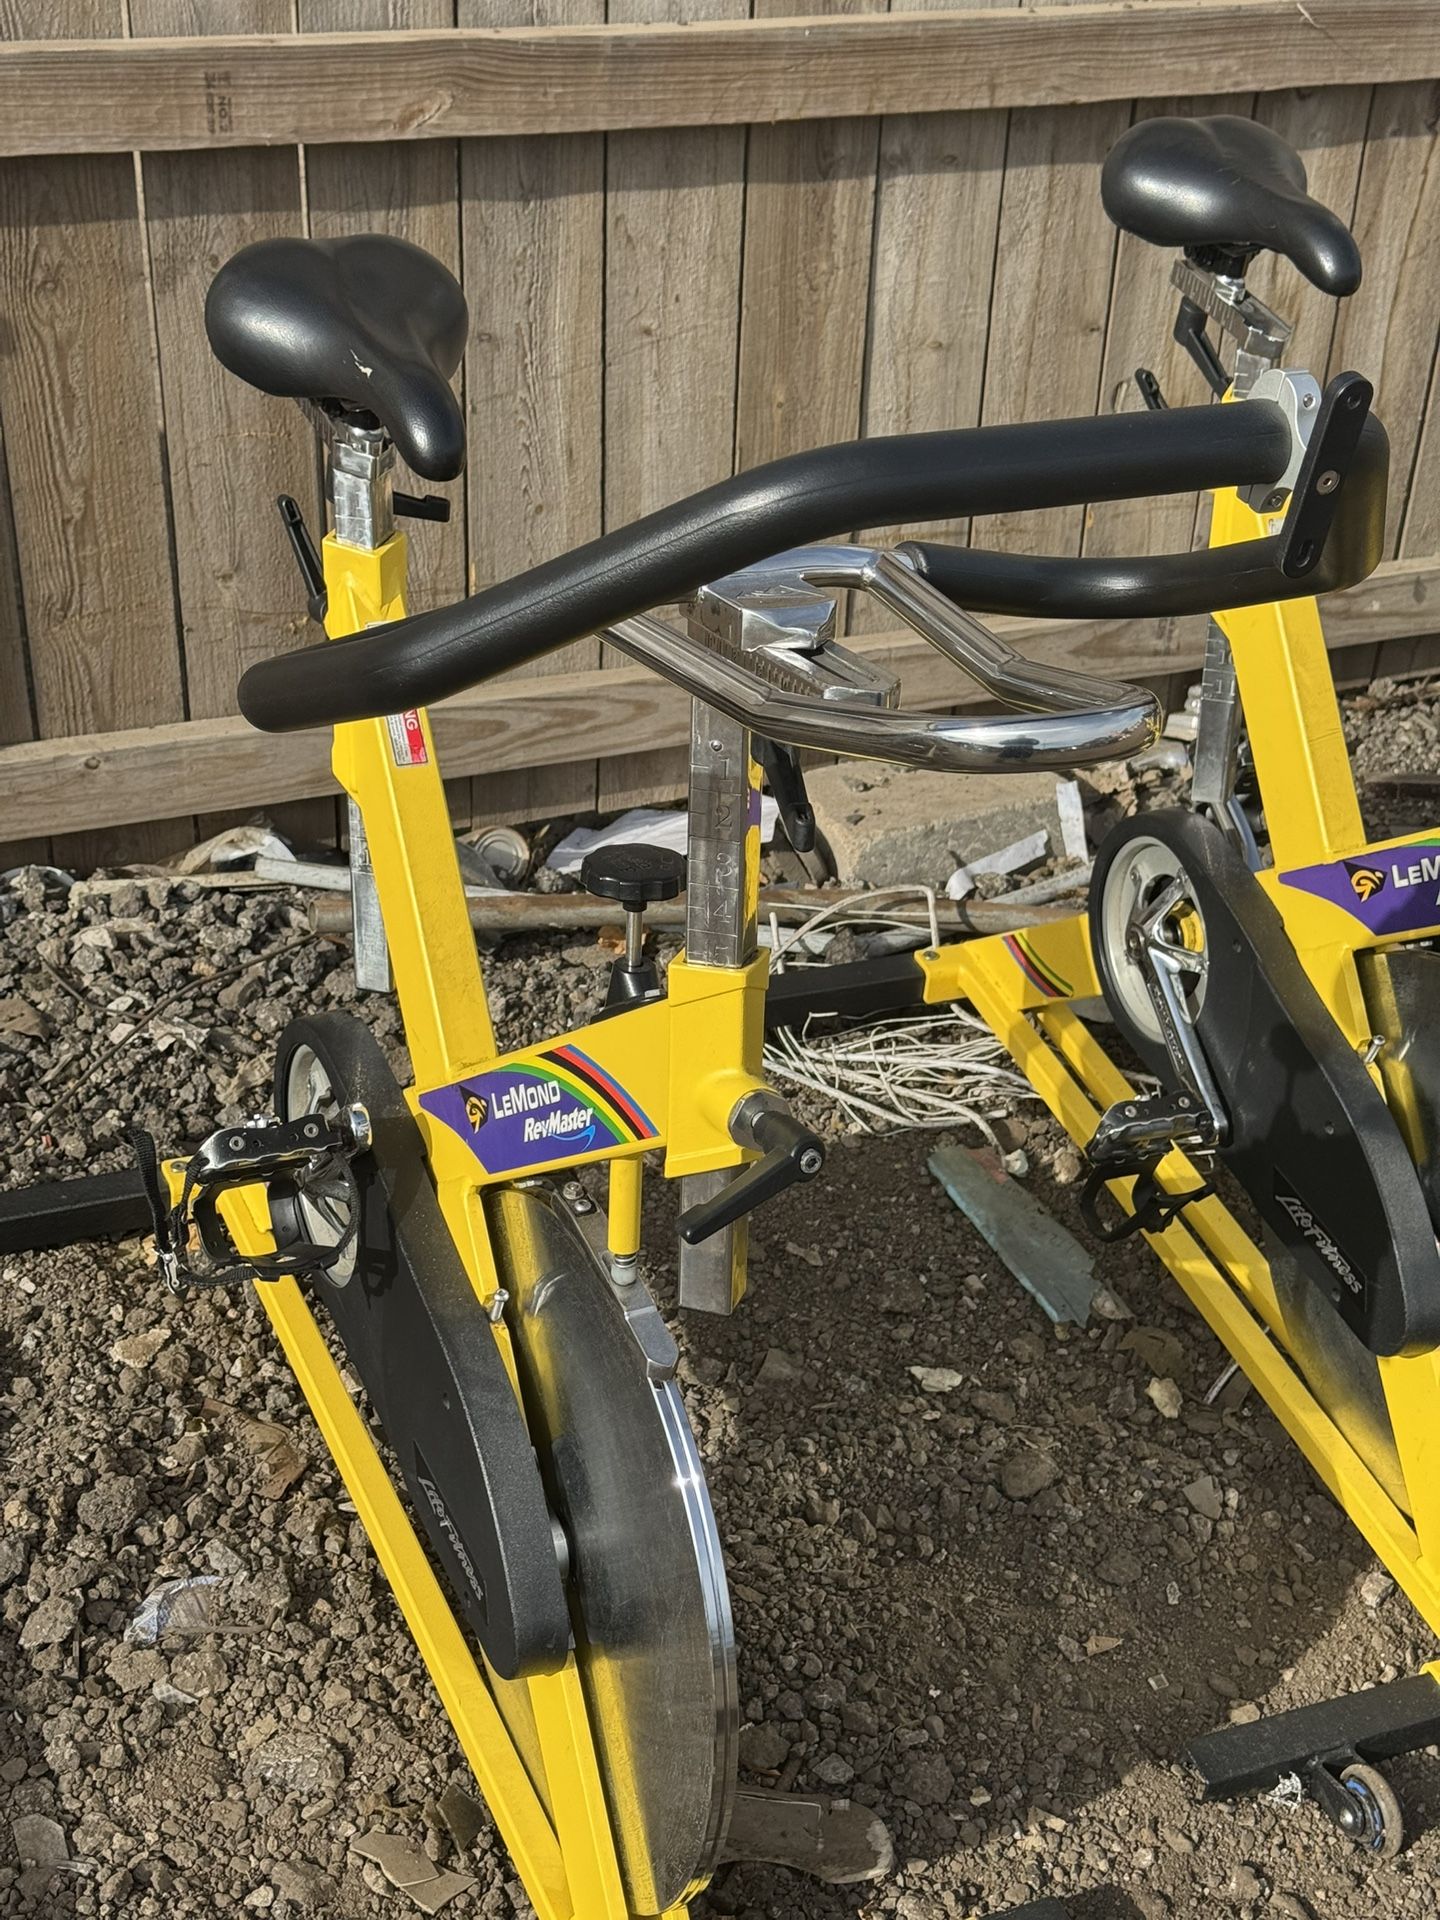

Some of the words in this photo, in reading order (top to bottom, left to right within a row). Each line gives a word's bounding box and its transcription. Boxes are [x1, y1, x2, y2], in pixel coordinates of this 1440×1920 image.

[714, 804, 733, 830] 2
[716, 852, 733, 877] 3
[713, 900, 732, 924] 4
[523, 1107, 594, 1143] RevMaster
